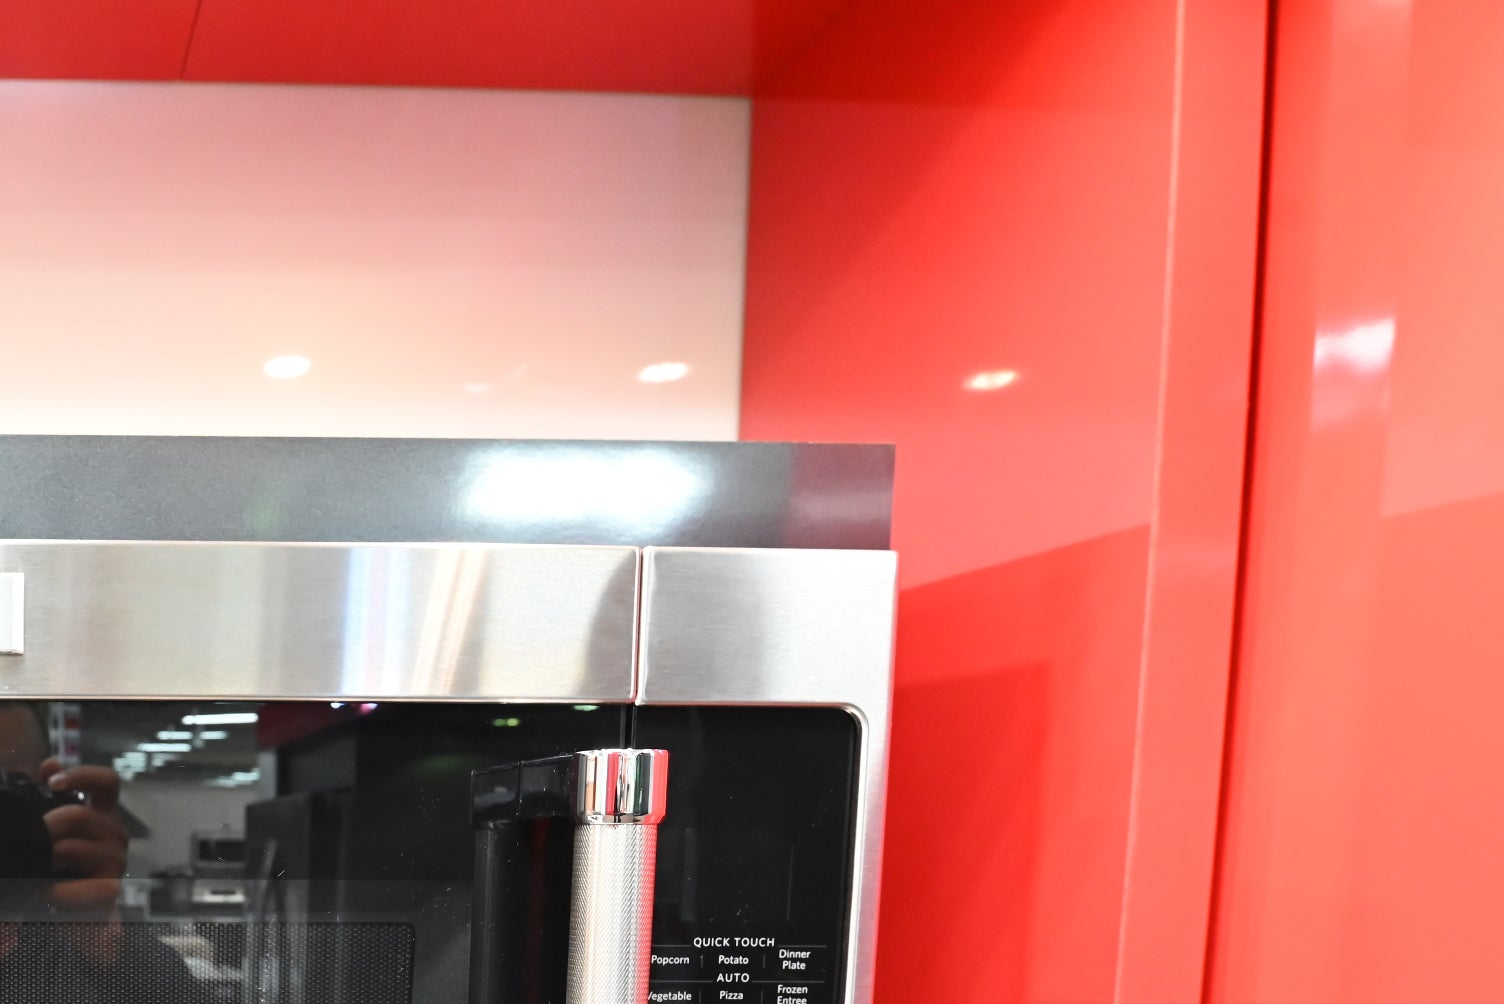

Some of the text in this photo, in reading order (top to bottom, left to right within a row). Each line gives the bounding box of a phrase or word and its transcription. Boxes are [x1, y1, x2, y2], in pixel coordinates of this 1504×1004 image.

[694, 937, 774, 948] QUICK TOUCH
[779, 949, 811, 958] Dinner
[651, 955, 689, 966] Popcorn
[719, 955, 749, 964] Potato
[783, 961, 806, 969] Plate
[717, 973, 749, 982] AUTO
[778, 985, 808, 994] Frozen
[720, 991, 743, 999] Pizza
[777, 996, 807, 1004] Entree
